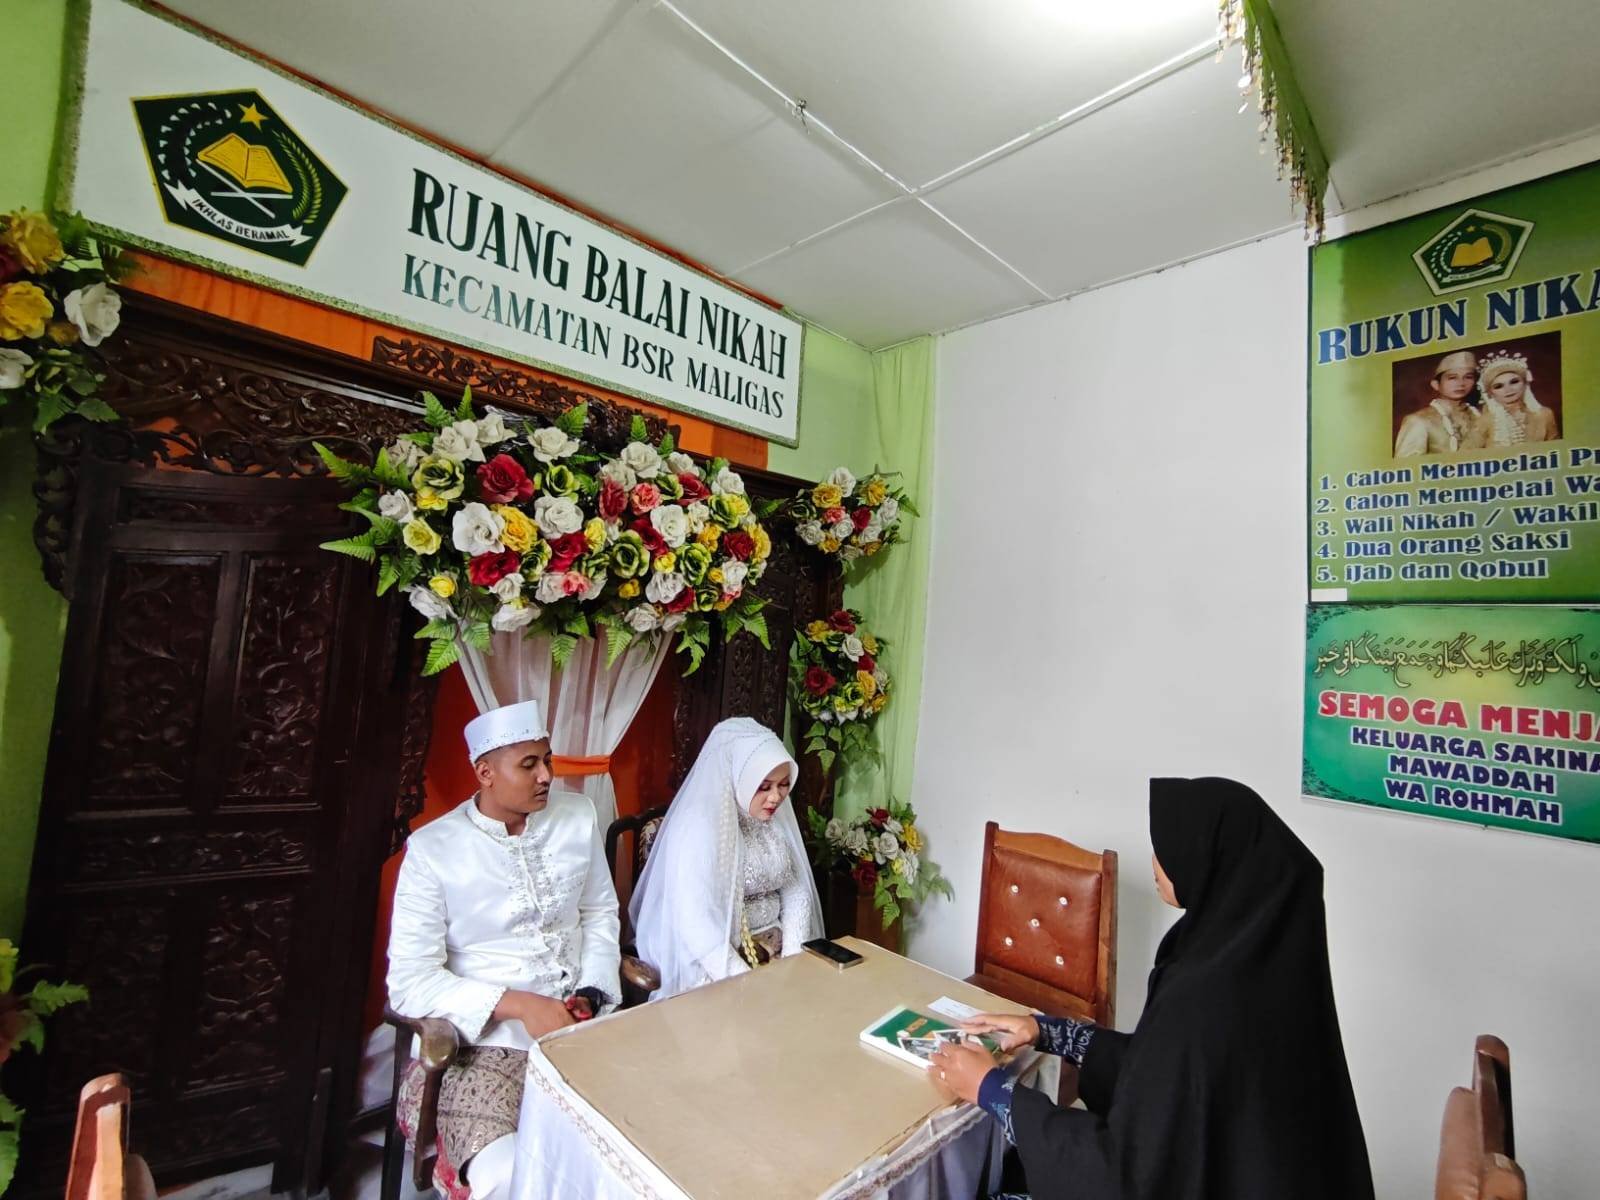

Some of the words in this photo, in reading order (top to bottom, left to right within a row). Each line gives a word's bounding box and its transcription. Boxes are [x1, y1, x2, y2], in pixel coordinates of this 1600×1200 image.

[192, 199, 233, 230] IKHLAS
[235, 225, 290, 240] BERAMAL
[407, 168, 571, 291] RUANG
[582, 245, 690, 339] BALAI
[697, 297, 787, 379] NIKAH
[402, 254, 610, 359] KECAMATAN
[622, 334, 674, 381] BSR
[686, 357, 783, 418] MALIGAS
[1318, 300, 1466, 364] RUKUN
[1320, 475, 1337, 491] 1.
[1346, 468, 1412, 489] Calon
[1421, 450, 1558, 481] Mempelai
[1315, 498, 1336, 514] 2.
[1344, 492, 1410, 512] Calon
[1418, 478, 1554, 506] Mempelai
[1316, 520, 1336, 536] 3.
[1345, 516, 1393, 535] Wali
[1402, 510, 1475, 532] Nikah
[1513, 502, 1598, 525] Wakil
[1315, 543, 1337, 559] 4.
[1344, 541, 1392, 558] Dua
[1400, 534, 1481, 556] Orang
[1492, 530, 1570, 551] Saksi
[1315, 566, 1336, 582] 5.
[1401, 562, 1451, 580] dan
[1460, 559, 1547, 580] Qobul
[1319, 691, 1467, 729] SEMOGA
[1481, 704, 1600, 742] MENJ
[1352, 727, 1486, 760] KELUARGA
[1390, 754, 1554, 795] MAWADDAH
[1385, 779, 1426, 804] WA
[1434, 787, 1561, 824] ROHMAH
